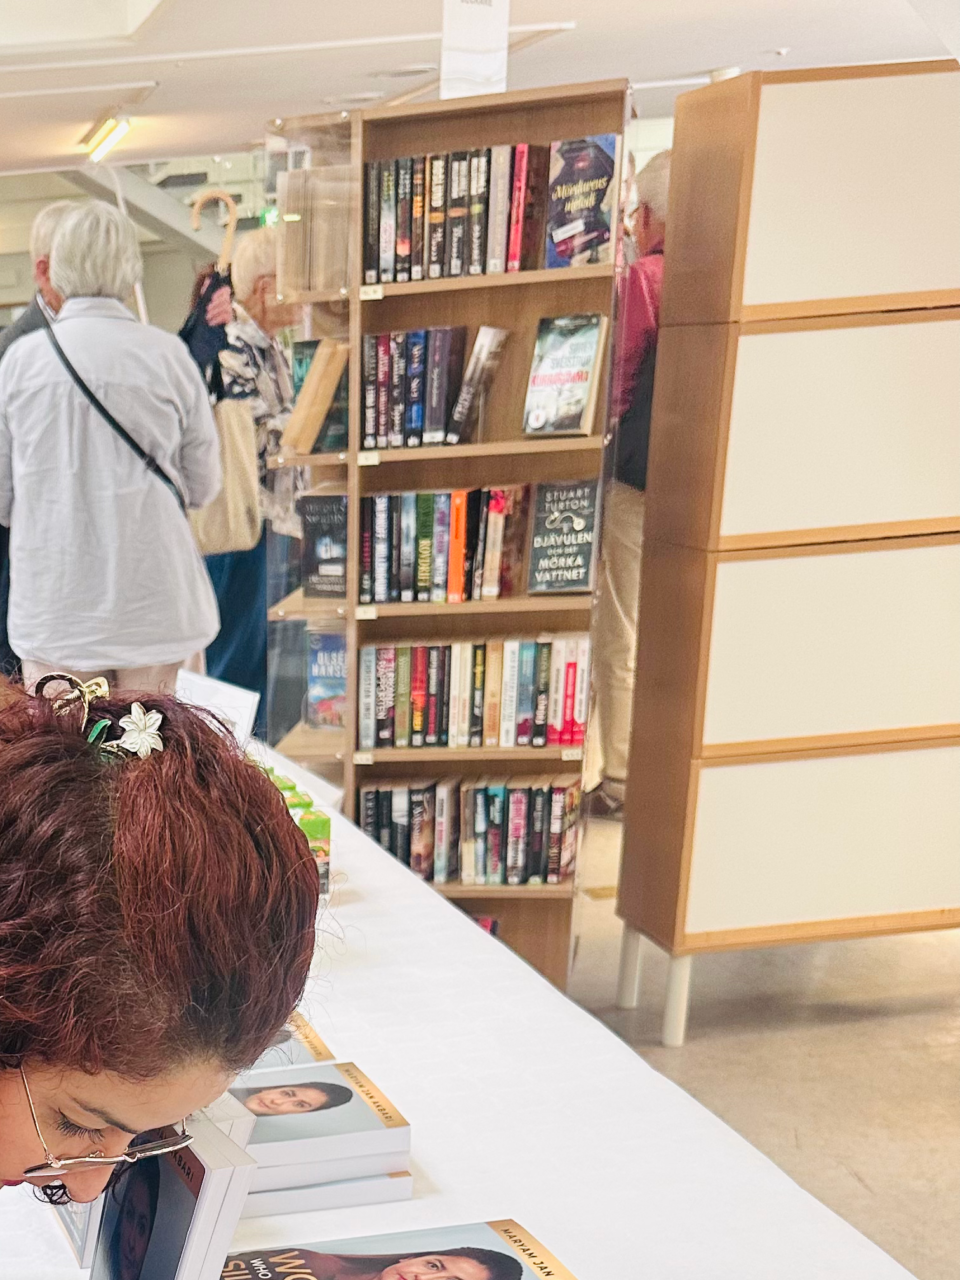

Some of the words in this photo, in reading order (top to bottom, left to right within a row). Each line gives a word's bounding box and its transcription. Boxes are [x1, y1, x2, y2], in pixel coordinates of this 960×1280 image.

[546, 487, 590, 501] STUART
[545, 499, 589, 512] TURTON
[534, 531, 593, 548] DJÄVULEN
[538, 554, 583, 570] MÖRKA
[535, 568, 586, 582] VATTNET
[501, 1228, 538, 1259] MARYAM
[533, 1261, 555, 1277] JAN
[250, 1257, 272, 1279] WHO
